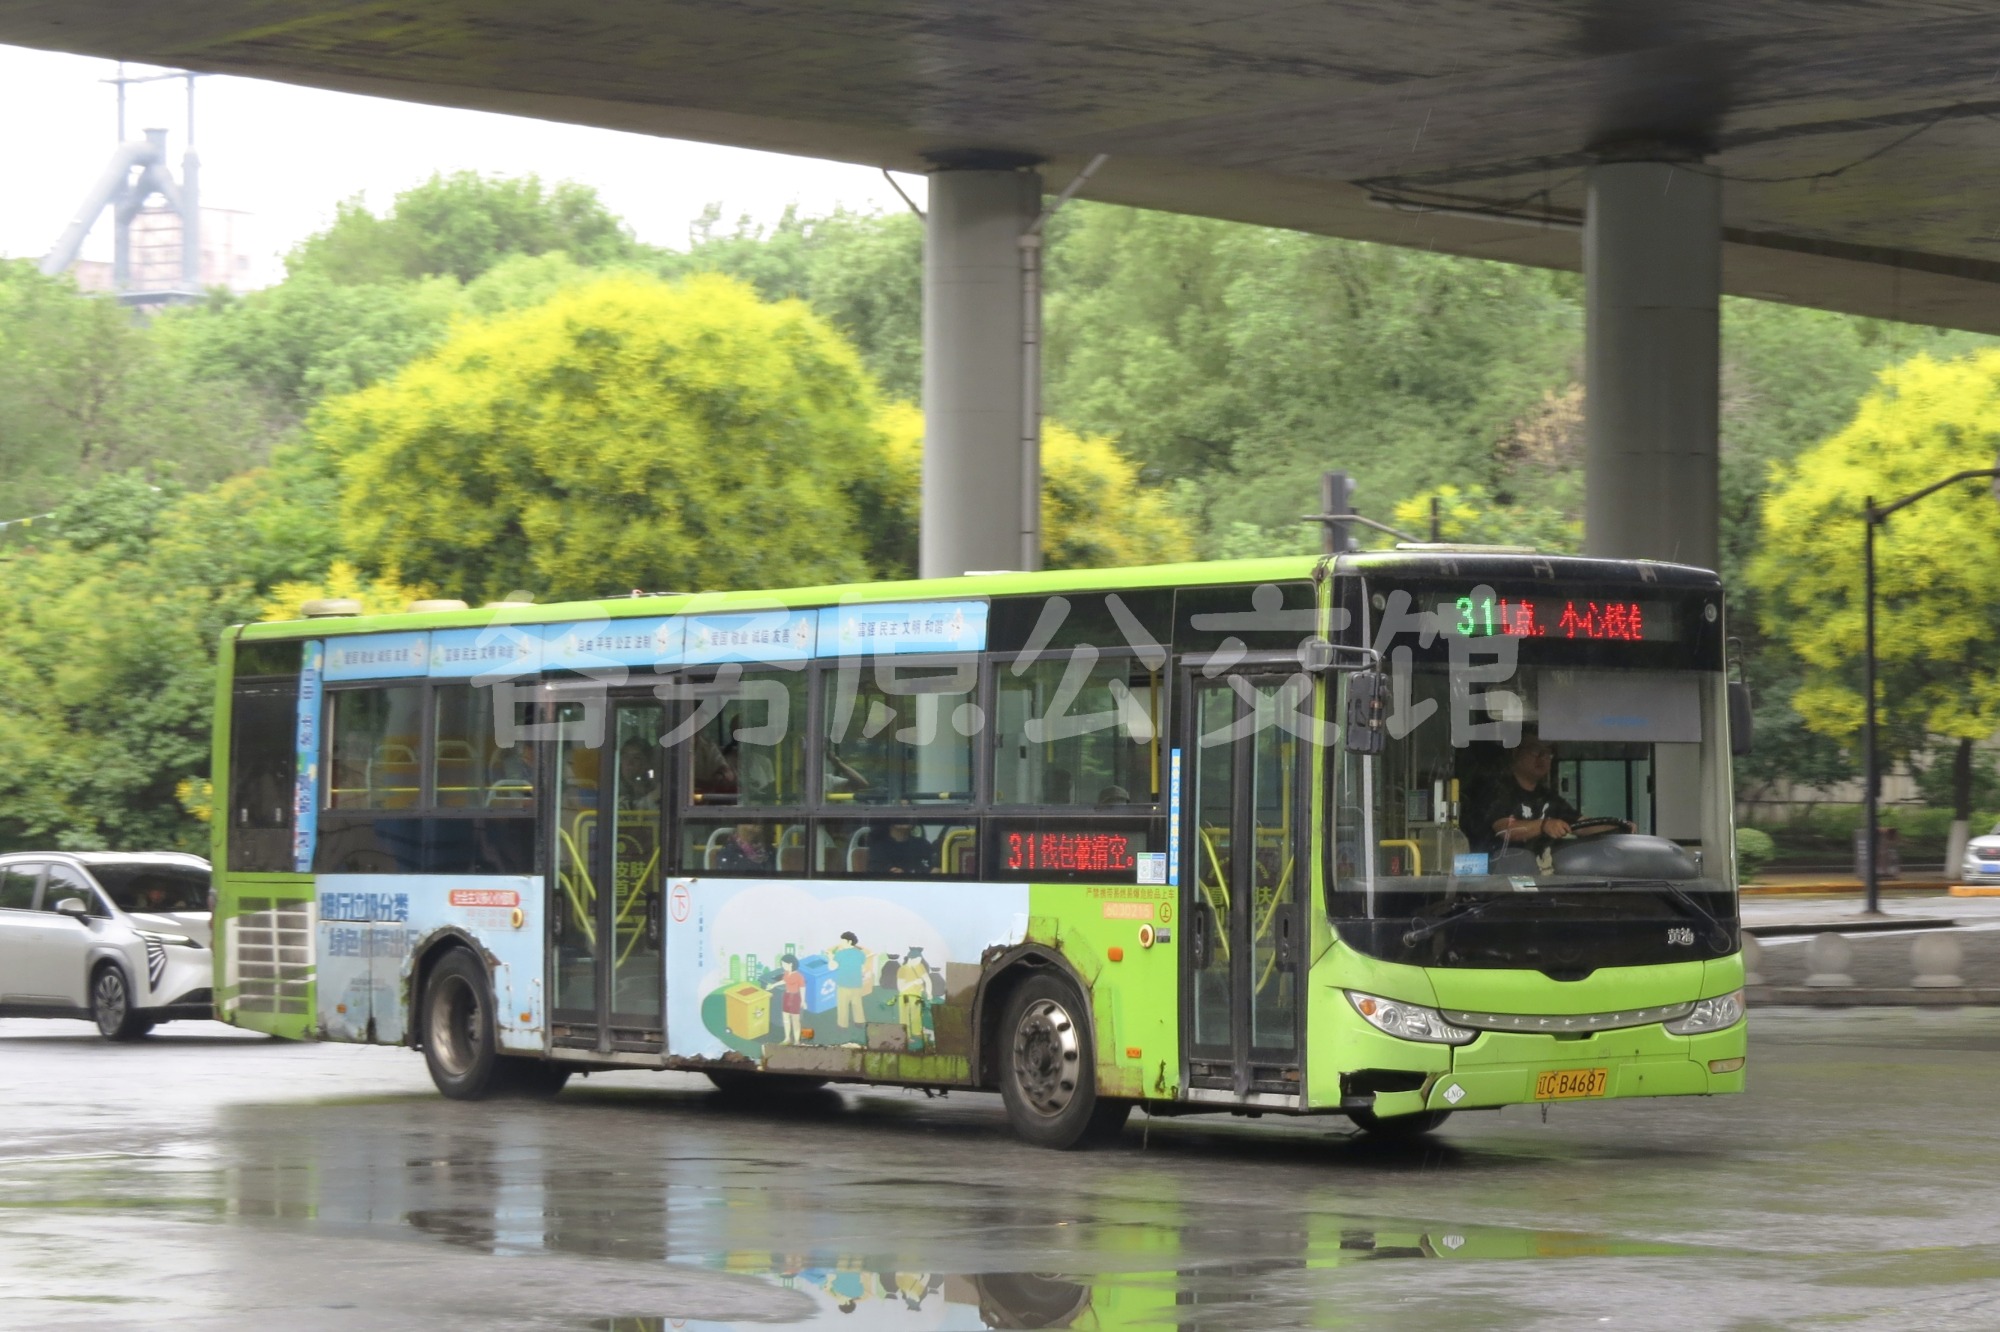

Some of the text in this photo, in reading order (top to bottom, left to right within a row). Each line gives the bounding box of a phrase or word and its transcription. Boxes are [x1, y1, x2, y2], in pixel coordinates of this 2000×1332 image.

[880, 621, 897, 636] 民主
[902, 619, 921, 635] 文明
[1456, 596, 1493, 636] 31
[1008, 832, 1036, 869] 31
[1446, 1089, 1462, 1099] LNG
